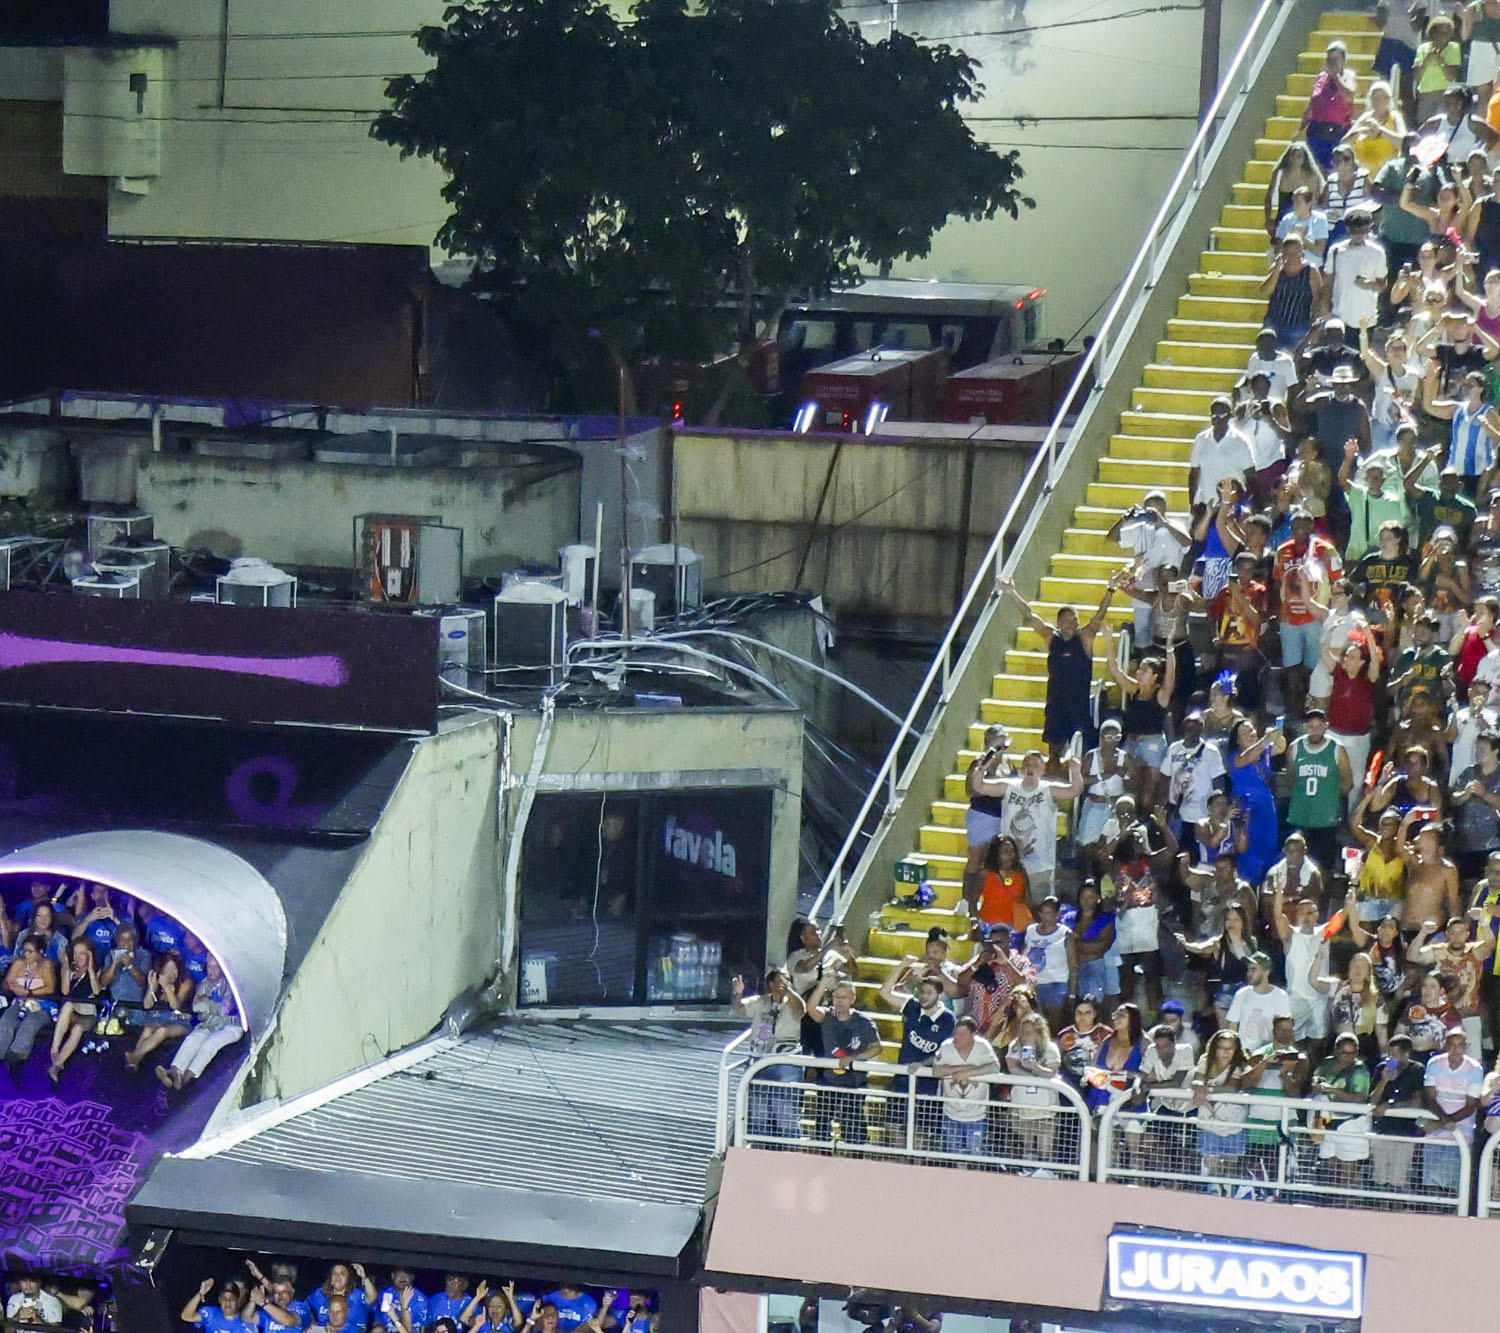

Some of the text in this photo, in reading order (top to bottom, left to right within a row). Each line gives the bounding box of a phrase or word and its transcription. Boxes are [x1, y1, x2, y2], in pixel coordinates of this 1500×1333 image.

[1298, 763, 1329, 778] BOSTON
[1306, 777, 1318, 796] 0
[1120, 1249, 1353, 1305] JURADOS
